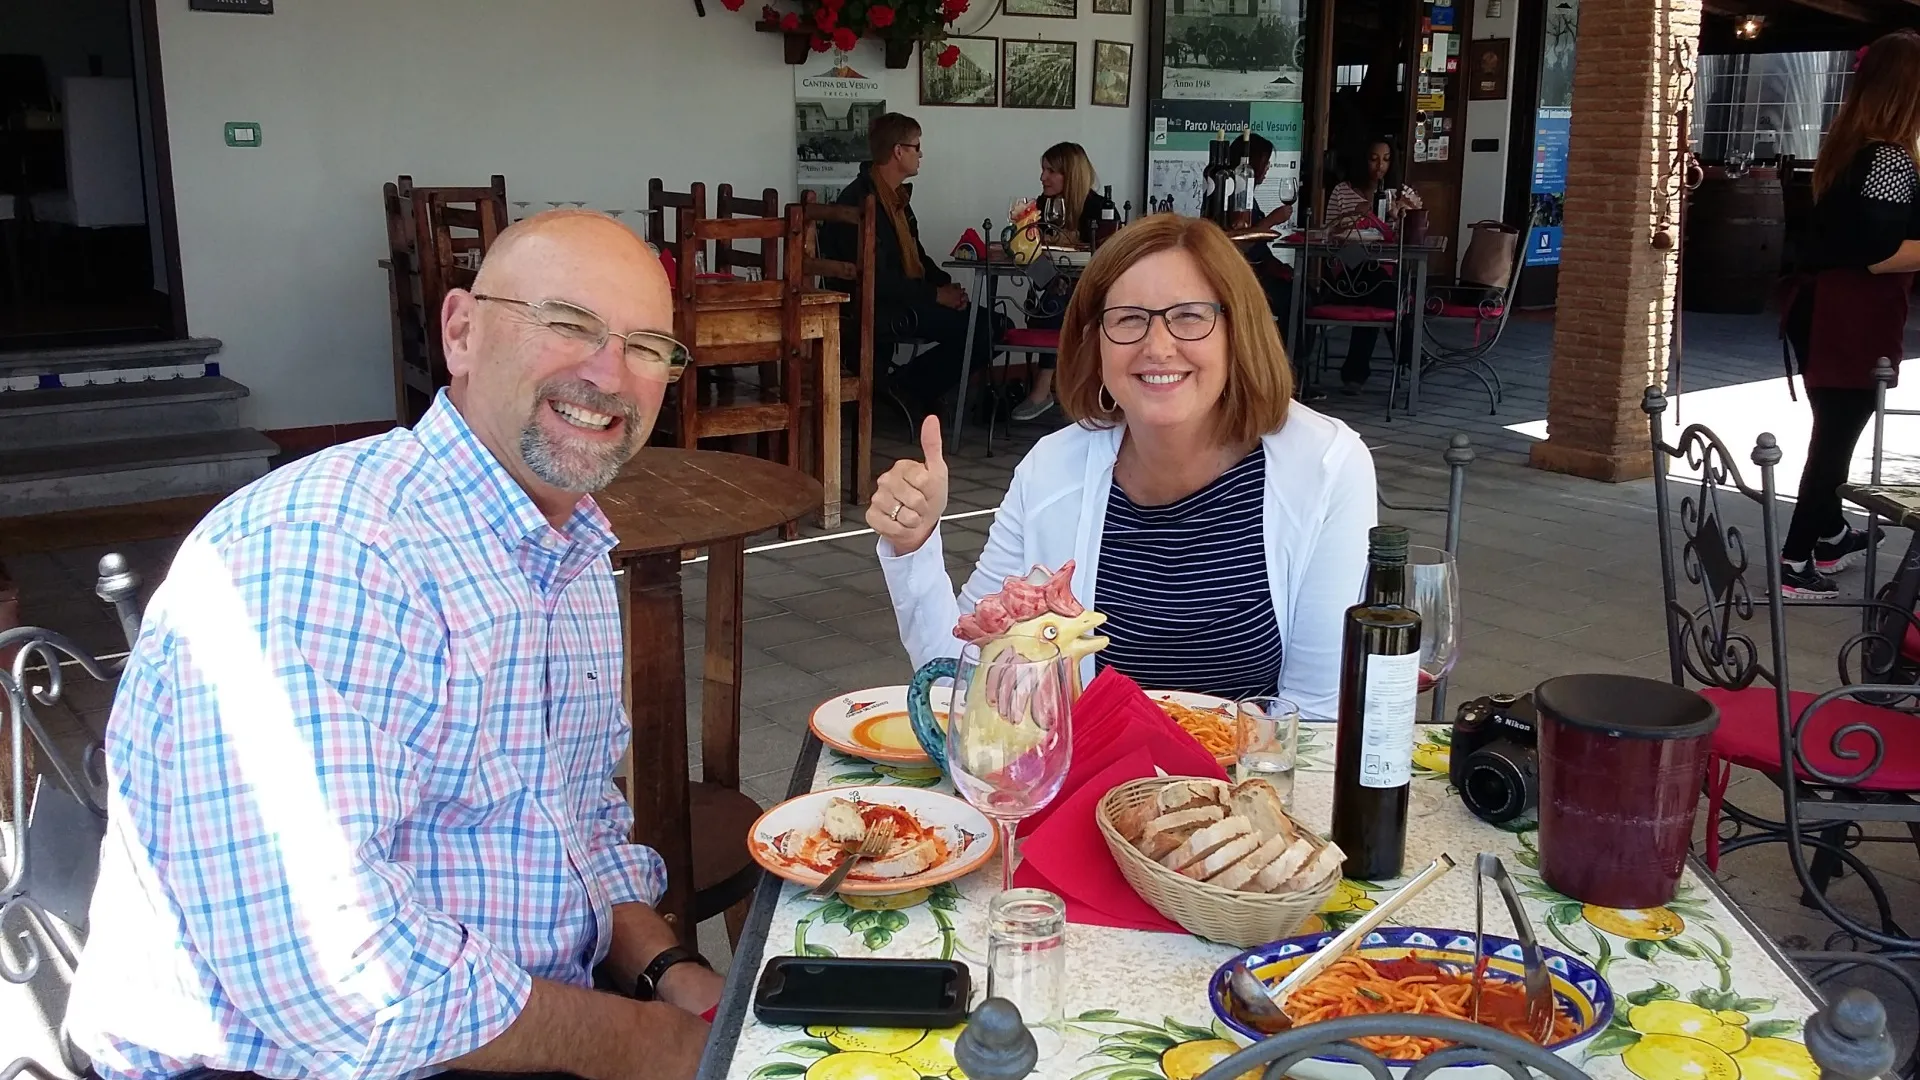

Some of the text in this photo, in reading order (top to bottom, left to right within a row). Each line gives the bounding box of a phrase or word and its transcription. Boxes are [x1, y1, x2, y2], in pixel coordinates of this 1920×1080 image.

[802, 79, 835, 88] CANTINA
[849, 81, 878, 90] VESUVIO
[1173, 79, 1211, 88] Anno 1948
[1185, 119, 1297, 132] Parco Nazionale del Vesuvio
[1505, 718, 1531, 731] Nikon
